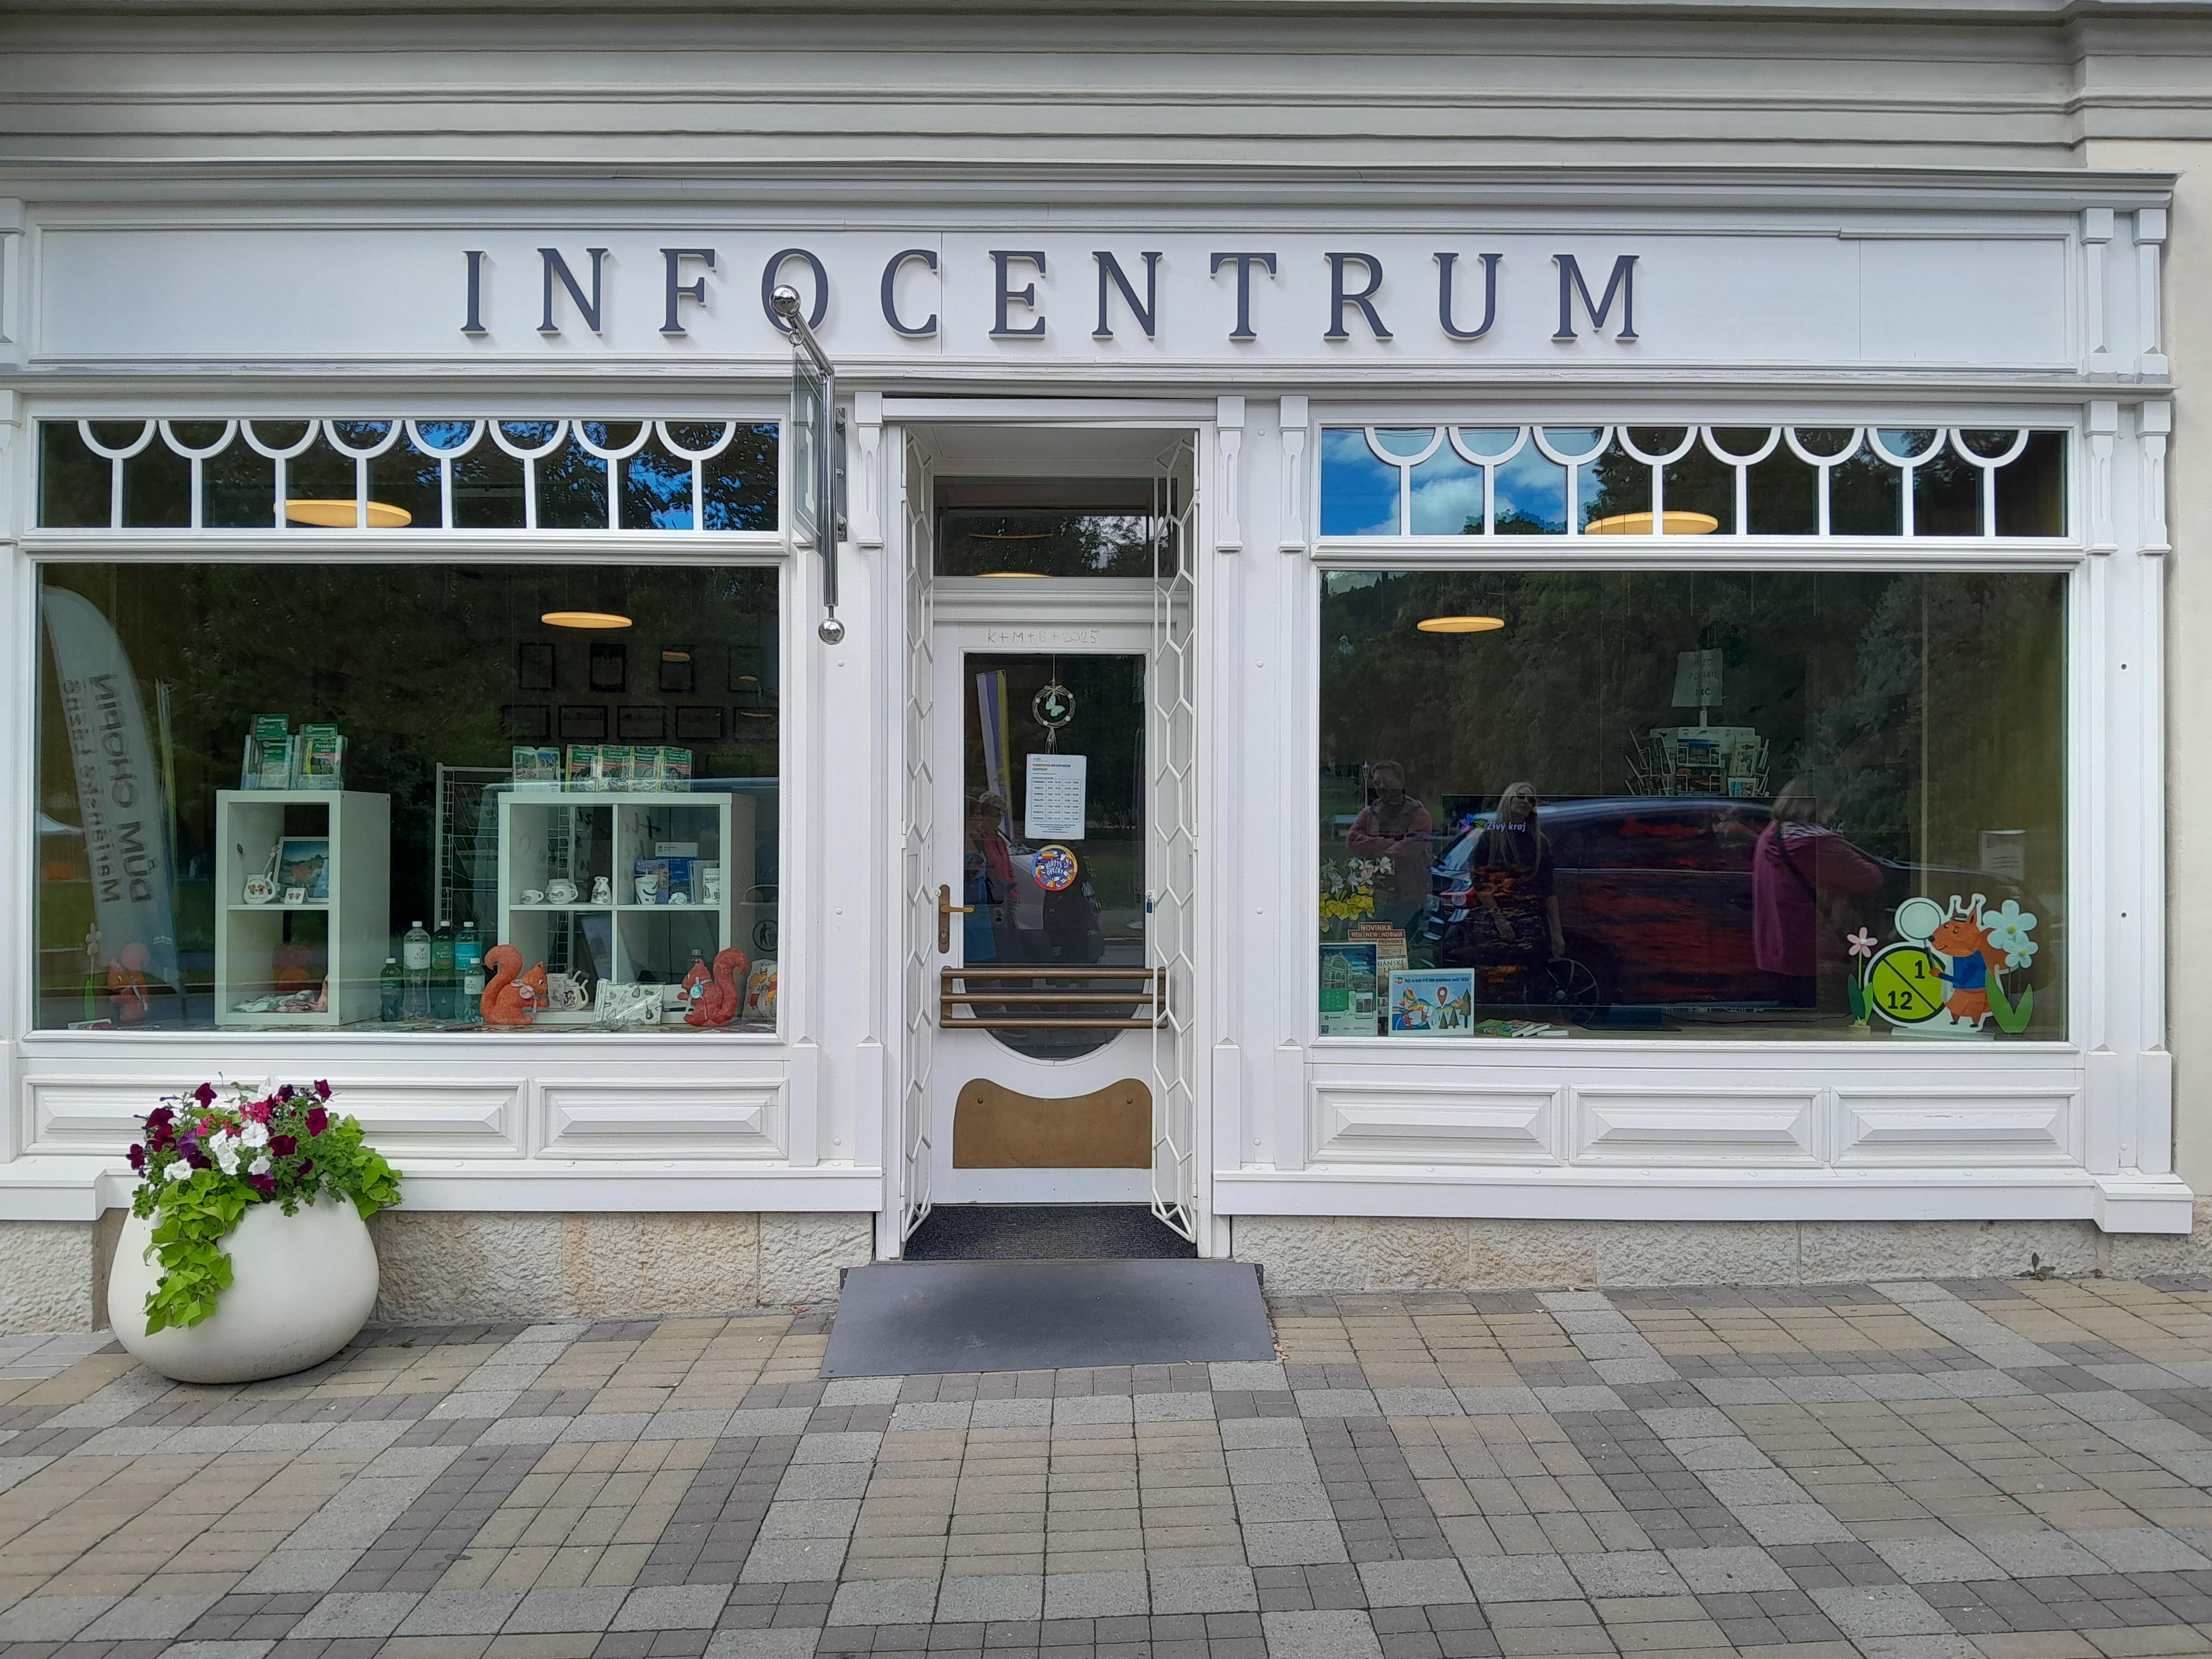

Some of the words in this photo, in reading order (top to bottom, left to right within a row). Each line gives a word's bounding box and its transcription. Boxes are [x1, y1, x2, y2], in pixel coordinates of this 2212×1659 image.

[460, 248, 1640, 341] INFOCENTRUM
[1486, 820, 1506, 833] Živý
[1509, 821, 1526, 832] kraj
[1914, 960, 1926, 979] 1
[1887, 990, 1913, 1010] 12
